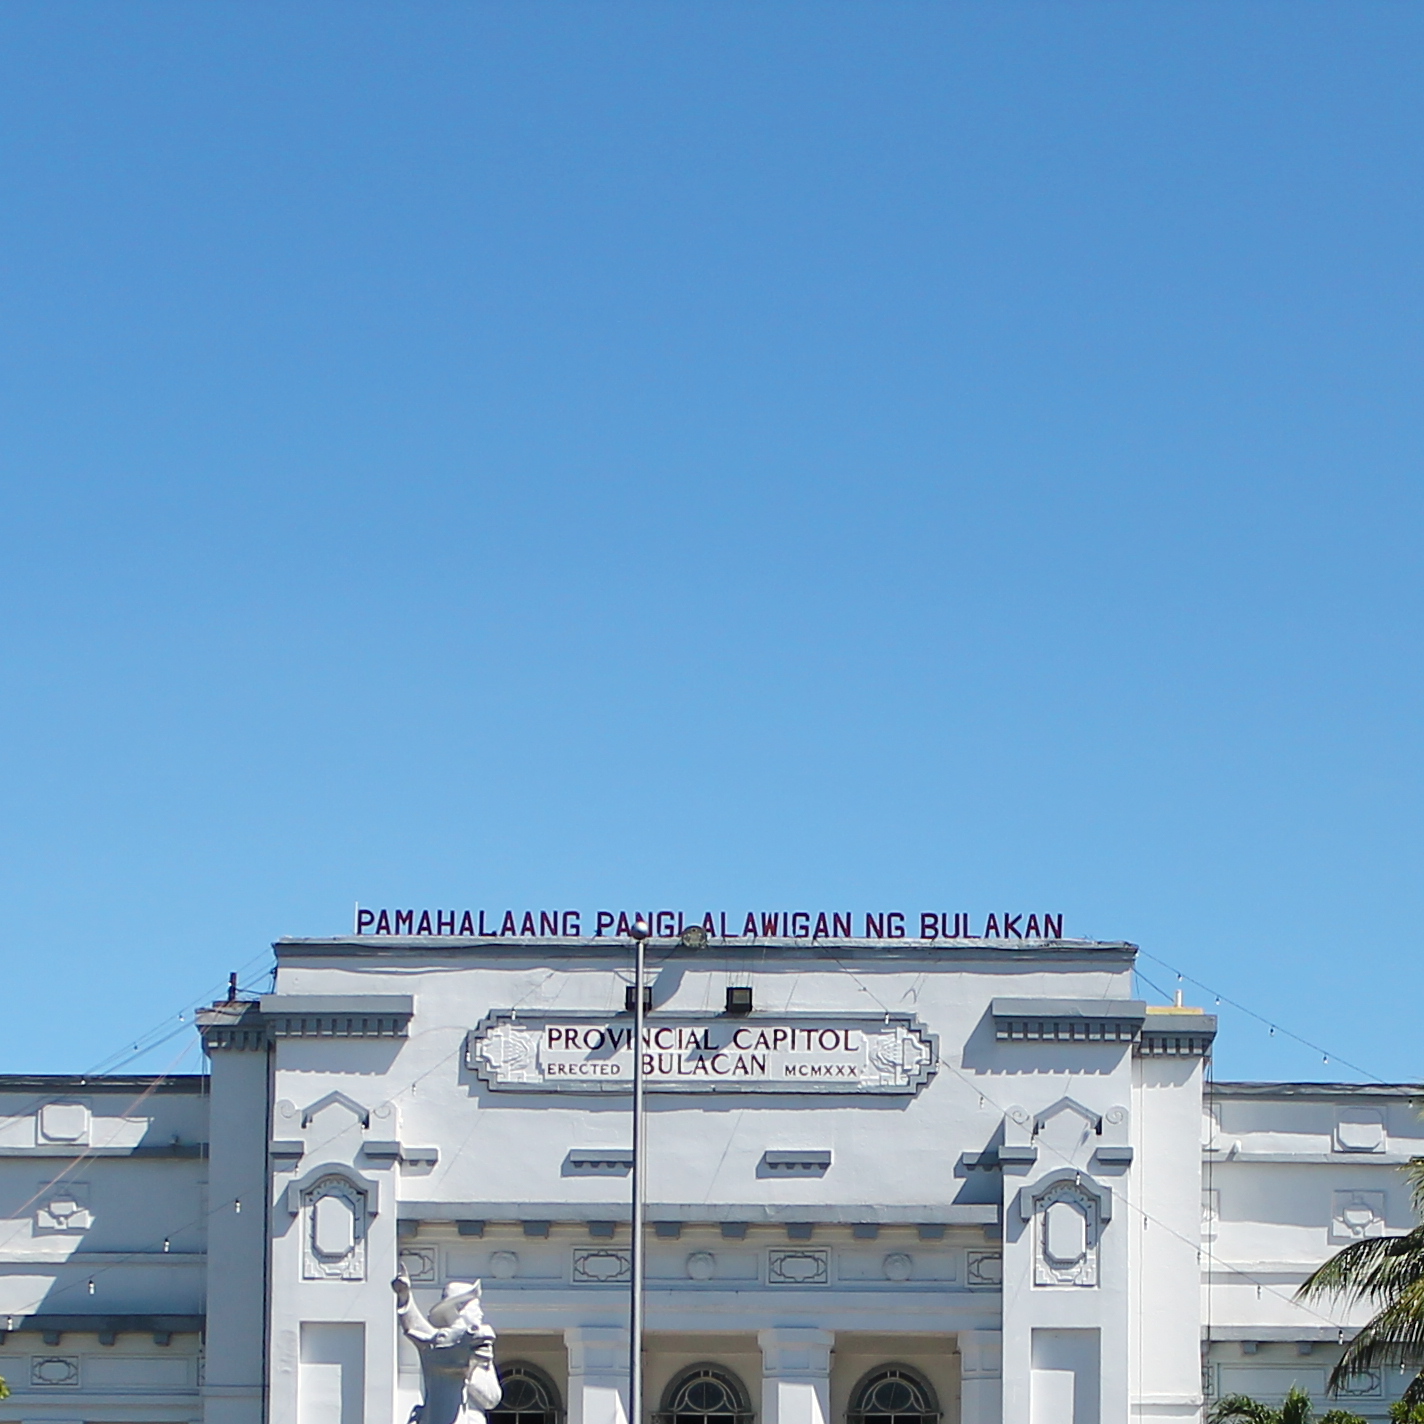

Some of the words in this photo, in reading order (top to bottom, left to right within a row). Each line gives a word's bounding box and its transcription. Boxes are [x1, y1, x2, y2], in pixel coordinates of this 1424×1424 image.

[357, 909, 580, 937] PAMAHALAANG
[866, 912, 905, 938] NG
[920, 912, 1063, 939] BULAKAN
[547, 1027, 720, 1051] PROVINCIAL
[732, 1028, 860, 1051] CAPITOL
[547, 1063, 621, 1075] ERECTED
[641, 1053, 766, 1076] BULACAN
[784, 1064, 857, 1077] MCMXXX
